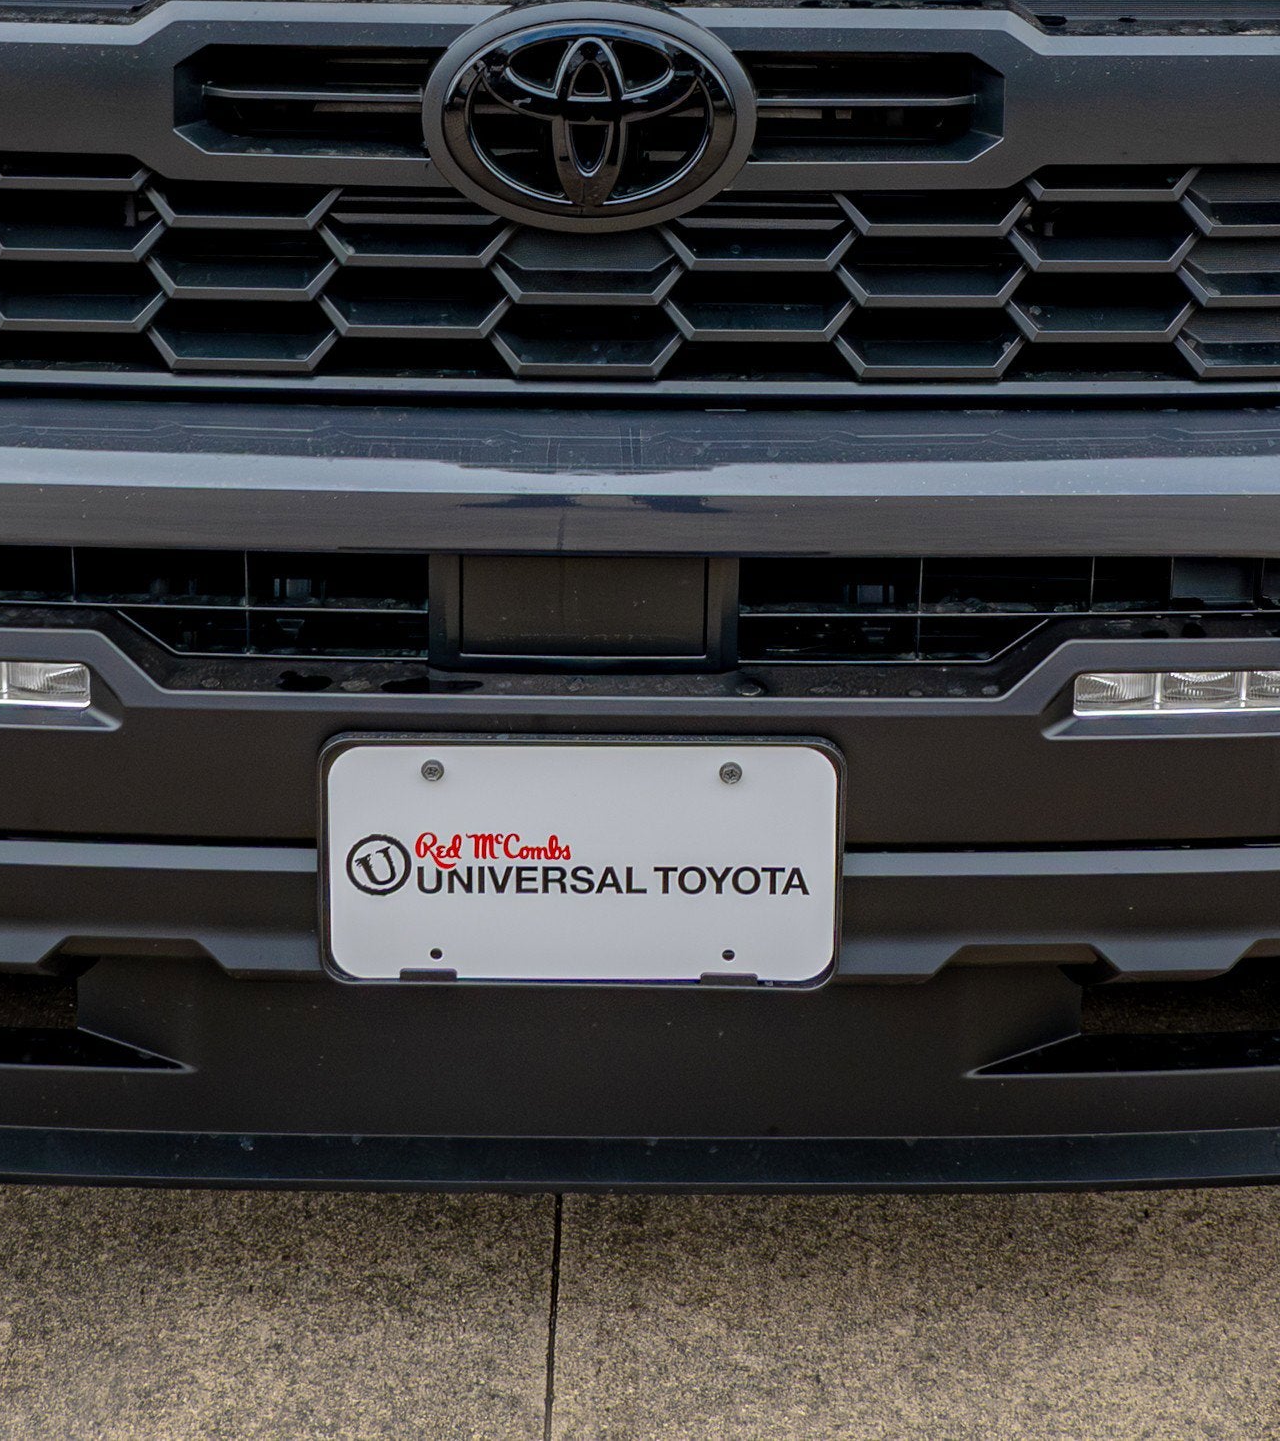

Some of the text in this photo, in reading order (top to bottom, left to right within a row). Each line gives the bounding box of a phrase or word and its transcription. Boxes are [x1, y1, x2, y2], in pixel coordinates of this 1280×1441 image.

[415, 832, 572, 870] Red McCombs
[417, 866, 810, 896] UNIVERSAL TOYOTA
